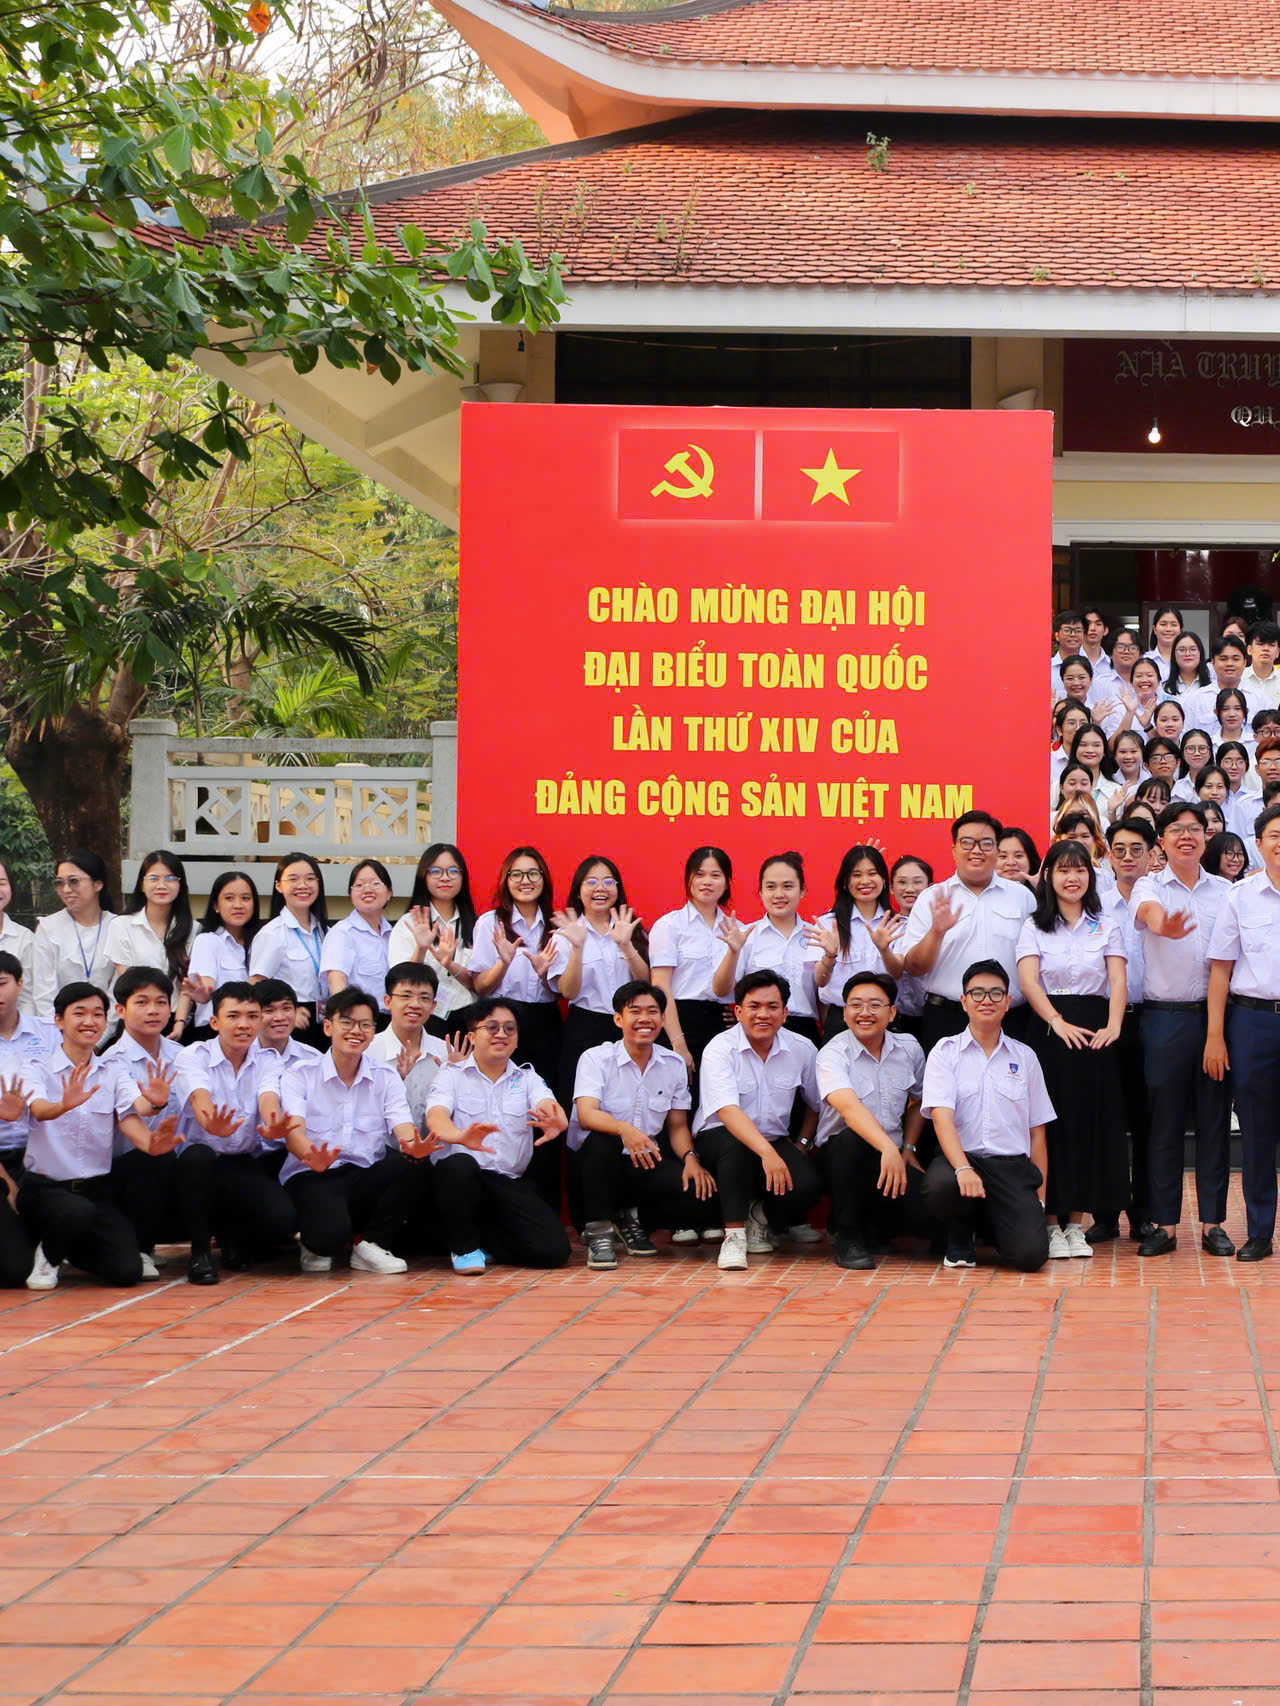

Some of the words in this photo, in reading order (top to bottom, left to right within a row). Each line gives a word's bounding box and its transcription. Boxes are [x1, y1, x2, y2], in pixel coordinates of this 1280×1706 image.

[588, 581, 678, 624] CHÀO
[690, 583, 788, 625] MỪNG
[799, 589, 857, 632] ĐẠI
[868, 584, 926, 632] HỘI
[583, 651, 640, 694] ĐẠI
[652, 638, 727, 688] BIỂU
[737, 647, 825, 689] TOÀN
[836, 642, 928, 693] QUỐC
[613, 703, 672, 751] LẦN
[683, 711, 753, 753] THỨ
[759, 717, 819, 753] XIV
[831, 709, 899, 754] CỦA
[535, 770, 626, 816] ĐẢNG
[637, 774, 729, 823] CỘNG
[741, 773, 806, 817] SẢN
[817, 776, 890, 825] VIỆT
[900, 783, 973, 819] NAM
